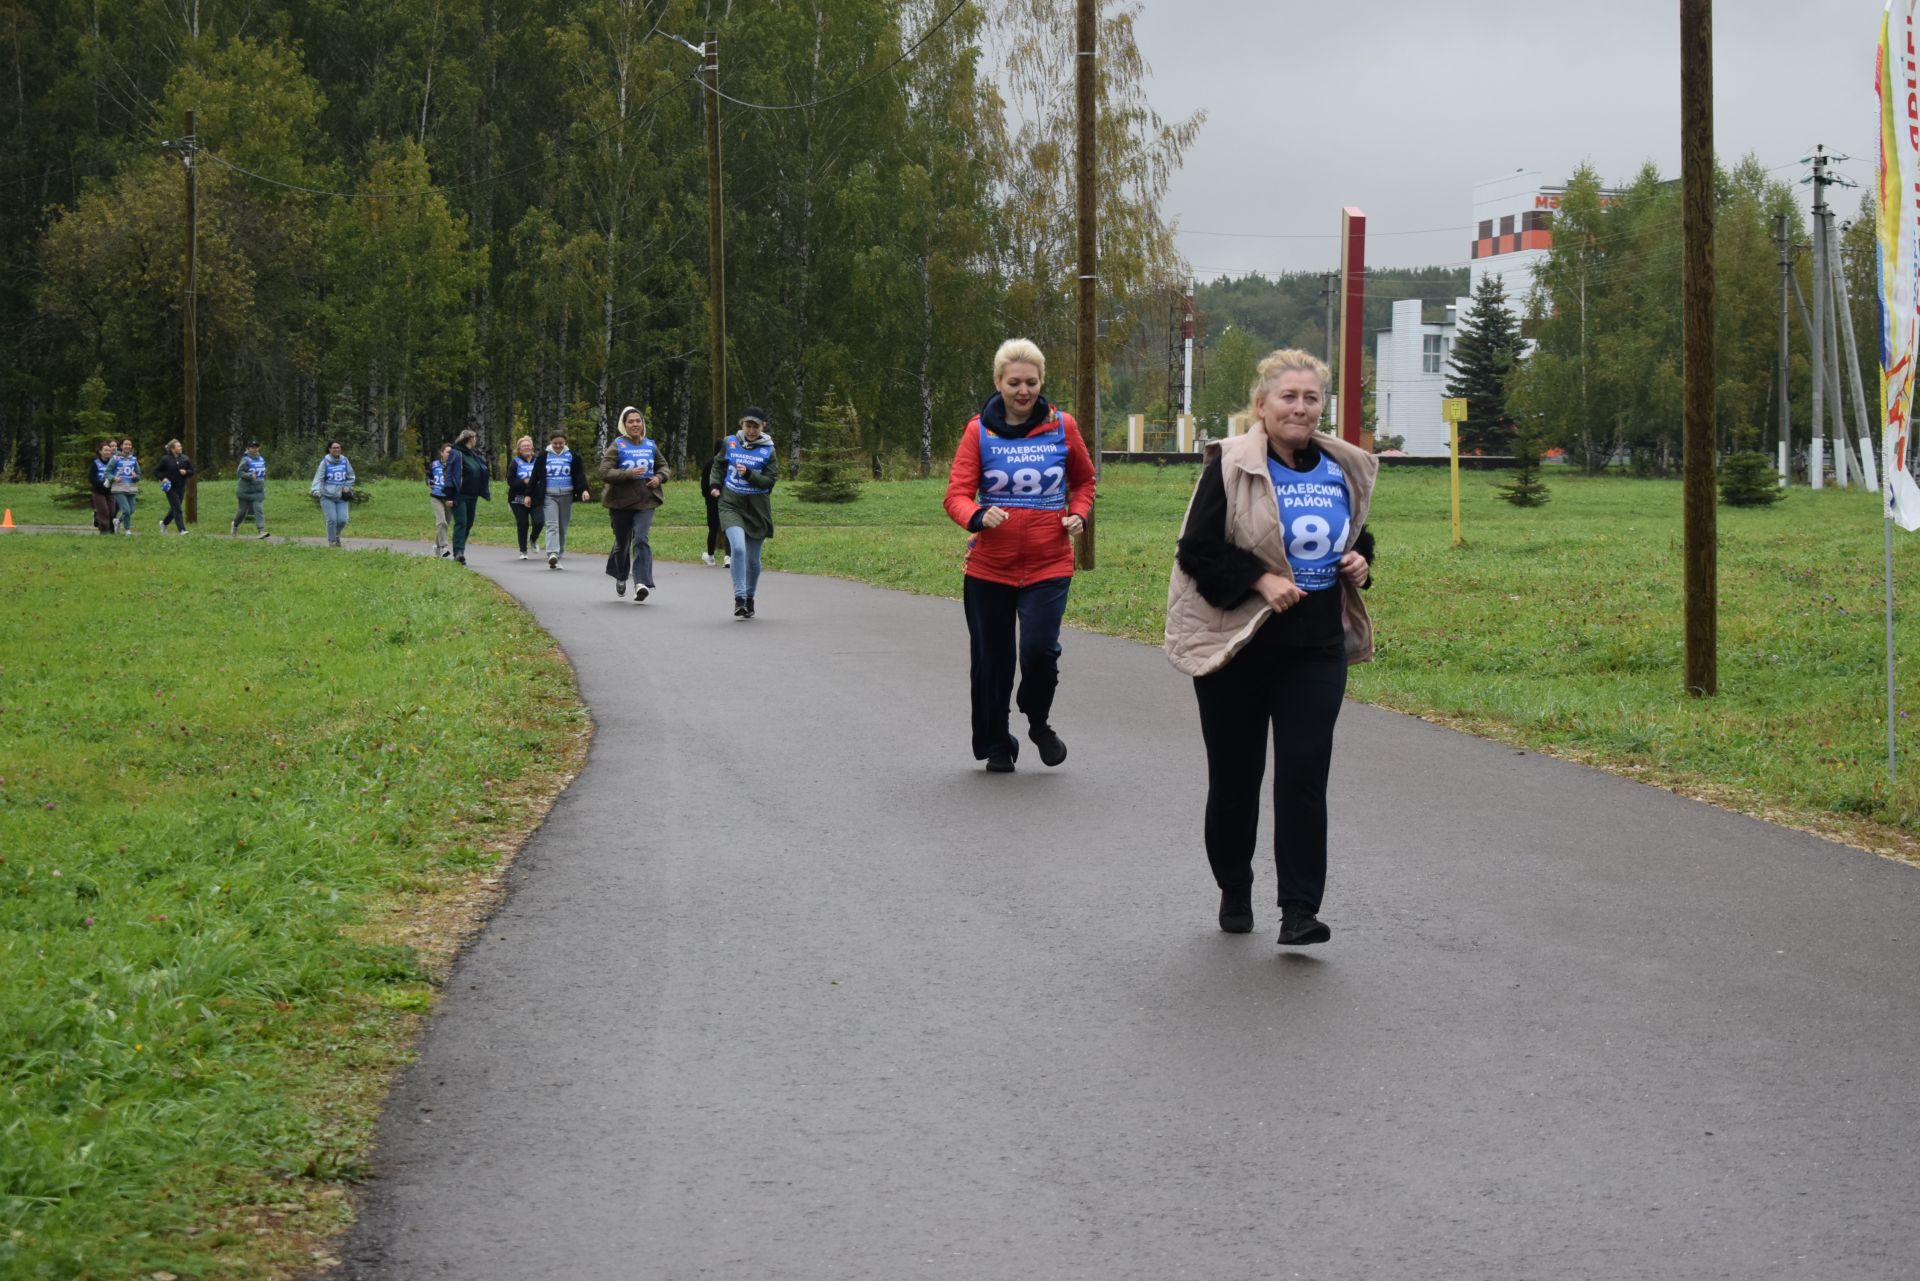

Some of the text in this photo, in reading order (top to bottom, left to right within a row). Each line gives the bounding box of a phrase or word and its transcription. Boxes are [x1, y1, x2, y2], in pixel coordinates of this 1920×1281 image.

[991, 444, 1057, 455] ТУКАЕВСКИЙ
[1006, 453, 1045, 464] РАЙОН
[983, 465, 1064, 496] 282
[1273, 484, 1343, 498] КАЕВСКИЙ
[1283, 494, 1333, 508] РАЙОН
